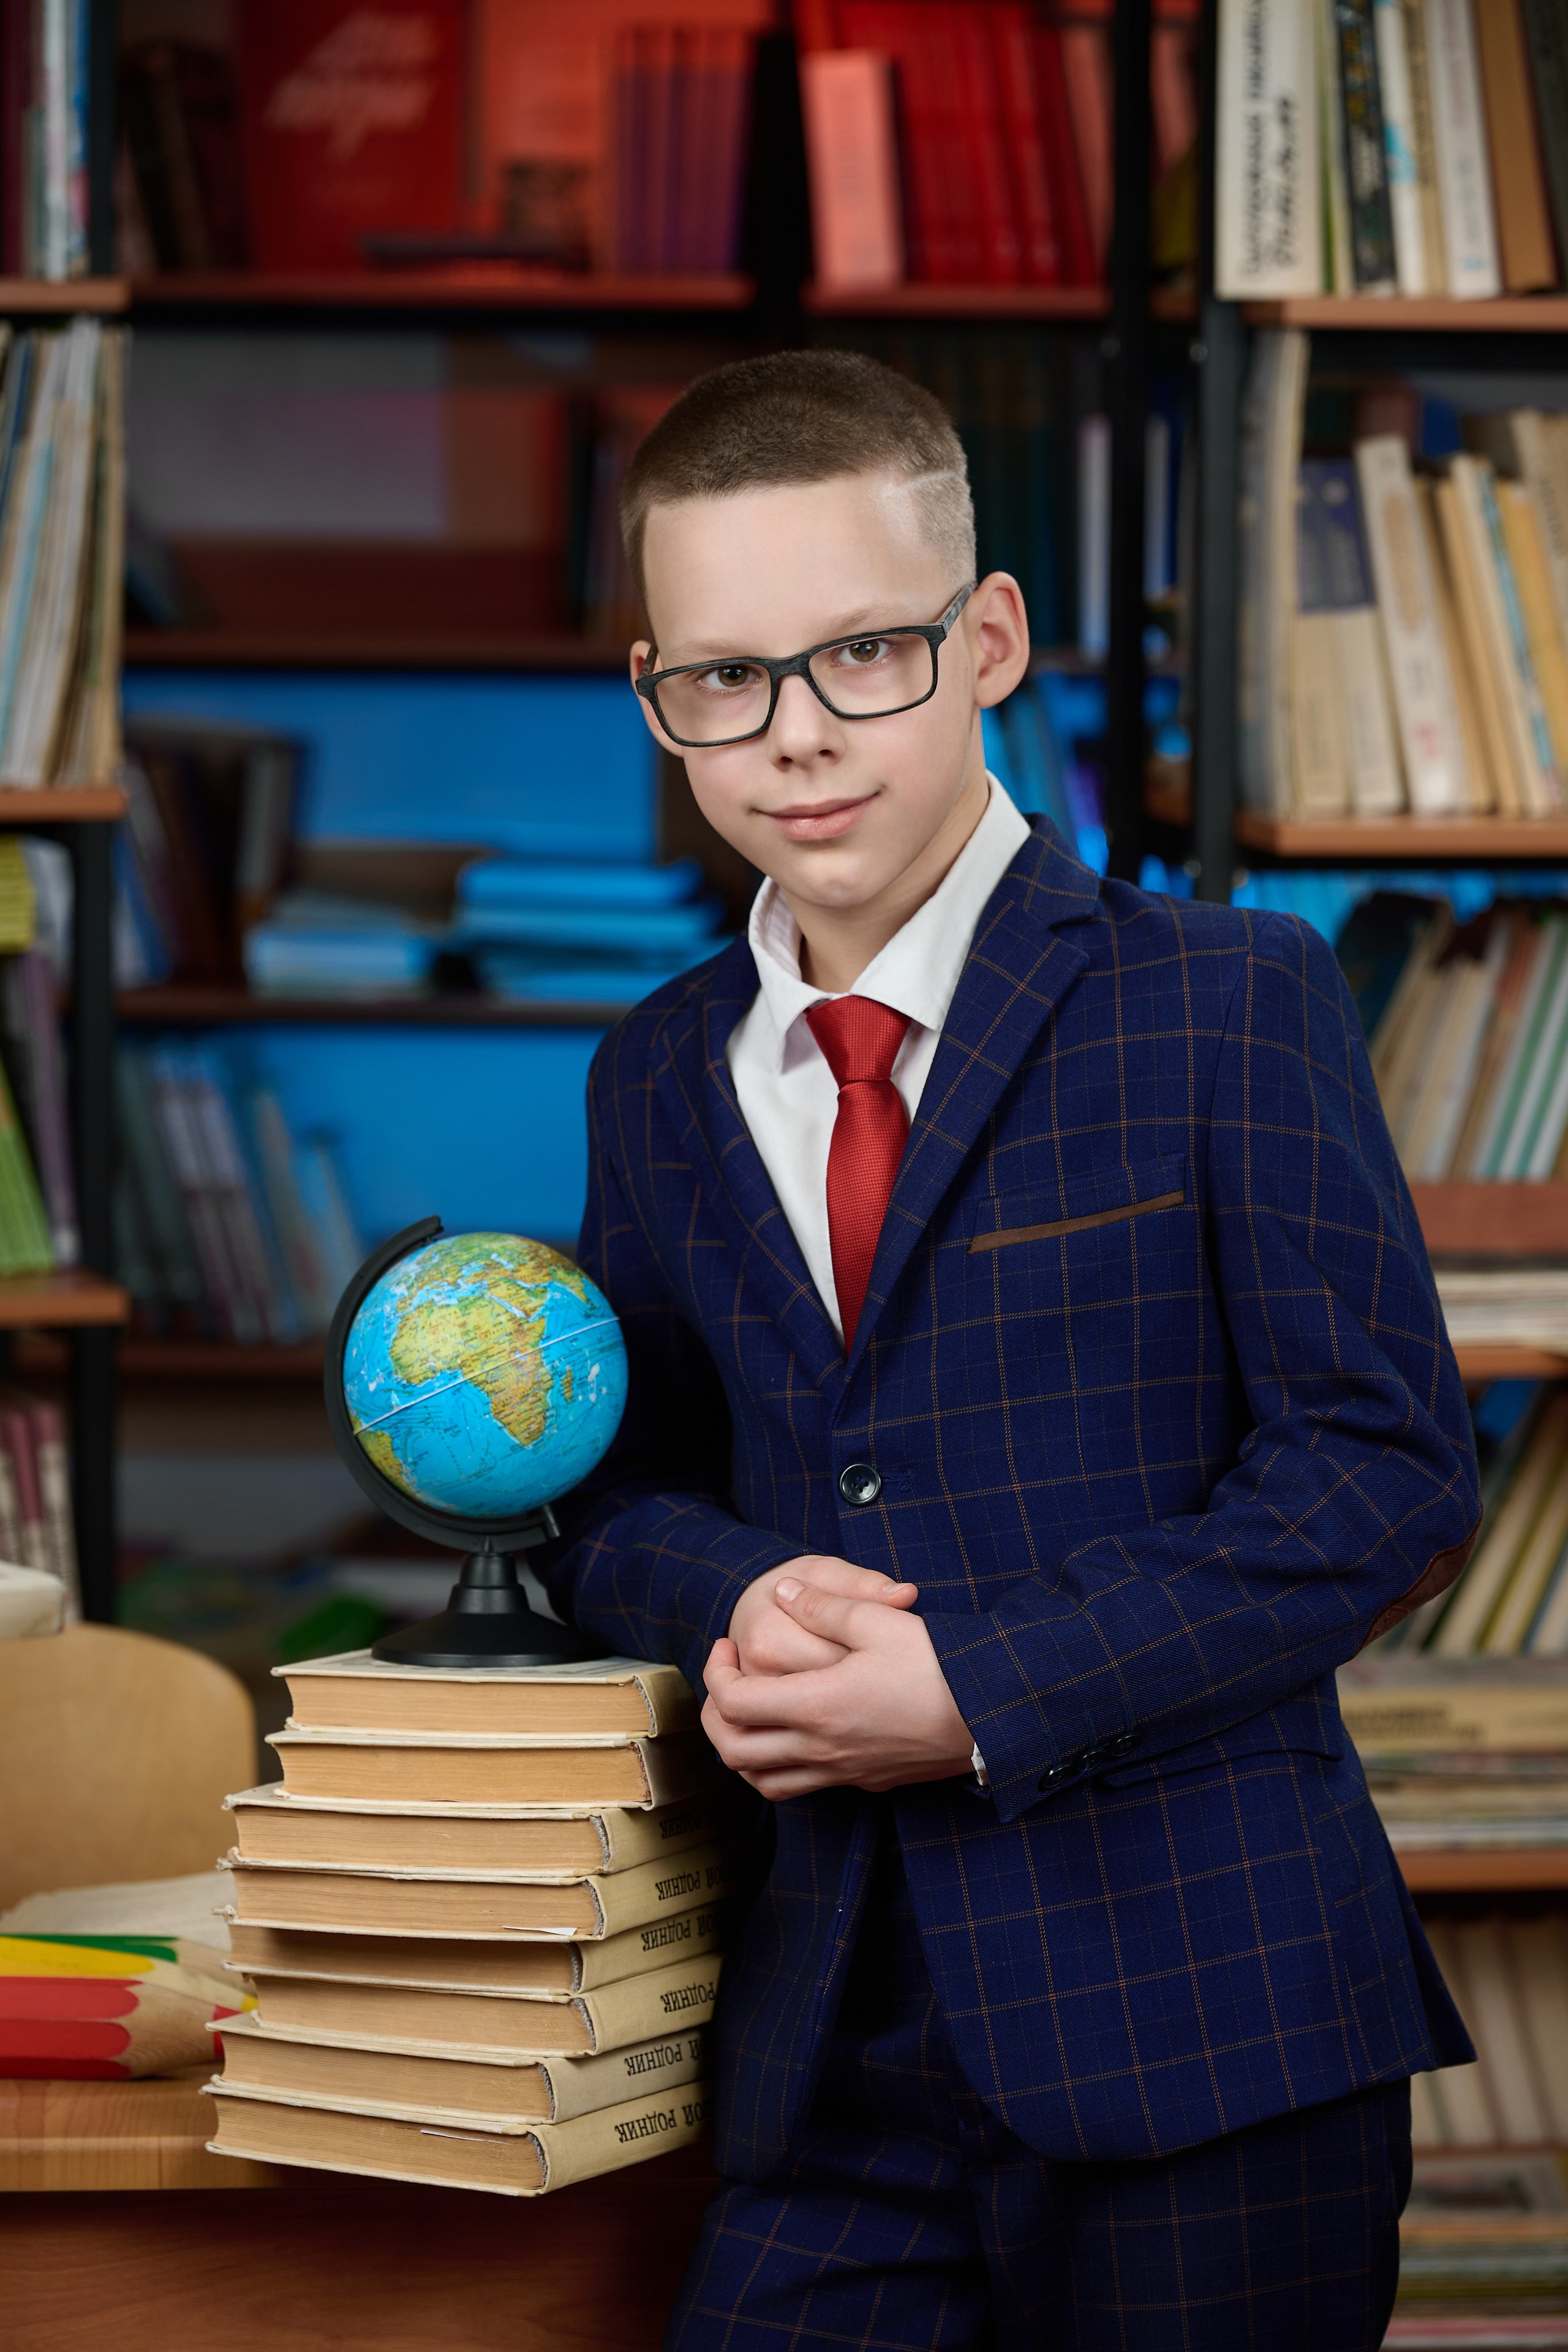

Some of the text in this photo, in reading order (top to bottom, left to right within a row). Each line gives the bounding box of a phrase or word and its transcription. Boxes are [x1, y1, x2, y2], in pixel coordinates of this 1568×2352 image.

[655, 1871, 701, 1901] РОДНИК
[641, 1920, 690, 1951] РОДНИК
[660, 1982, 717, 2013] РОДНИК
[625, 2044, 683, 2076] РОДНИК
[615, 2109, 678, 2143] РОДНИК
